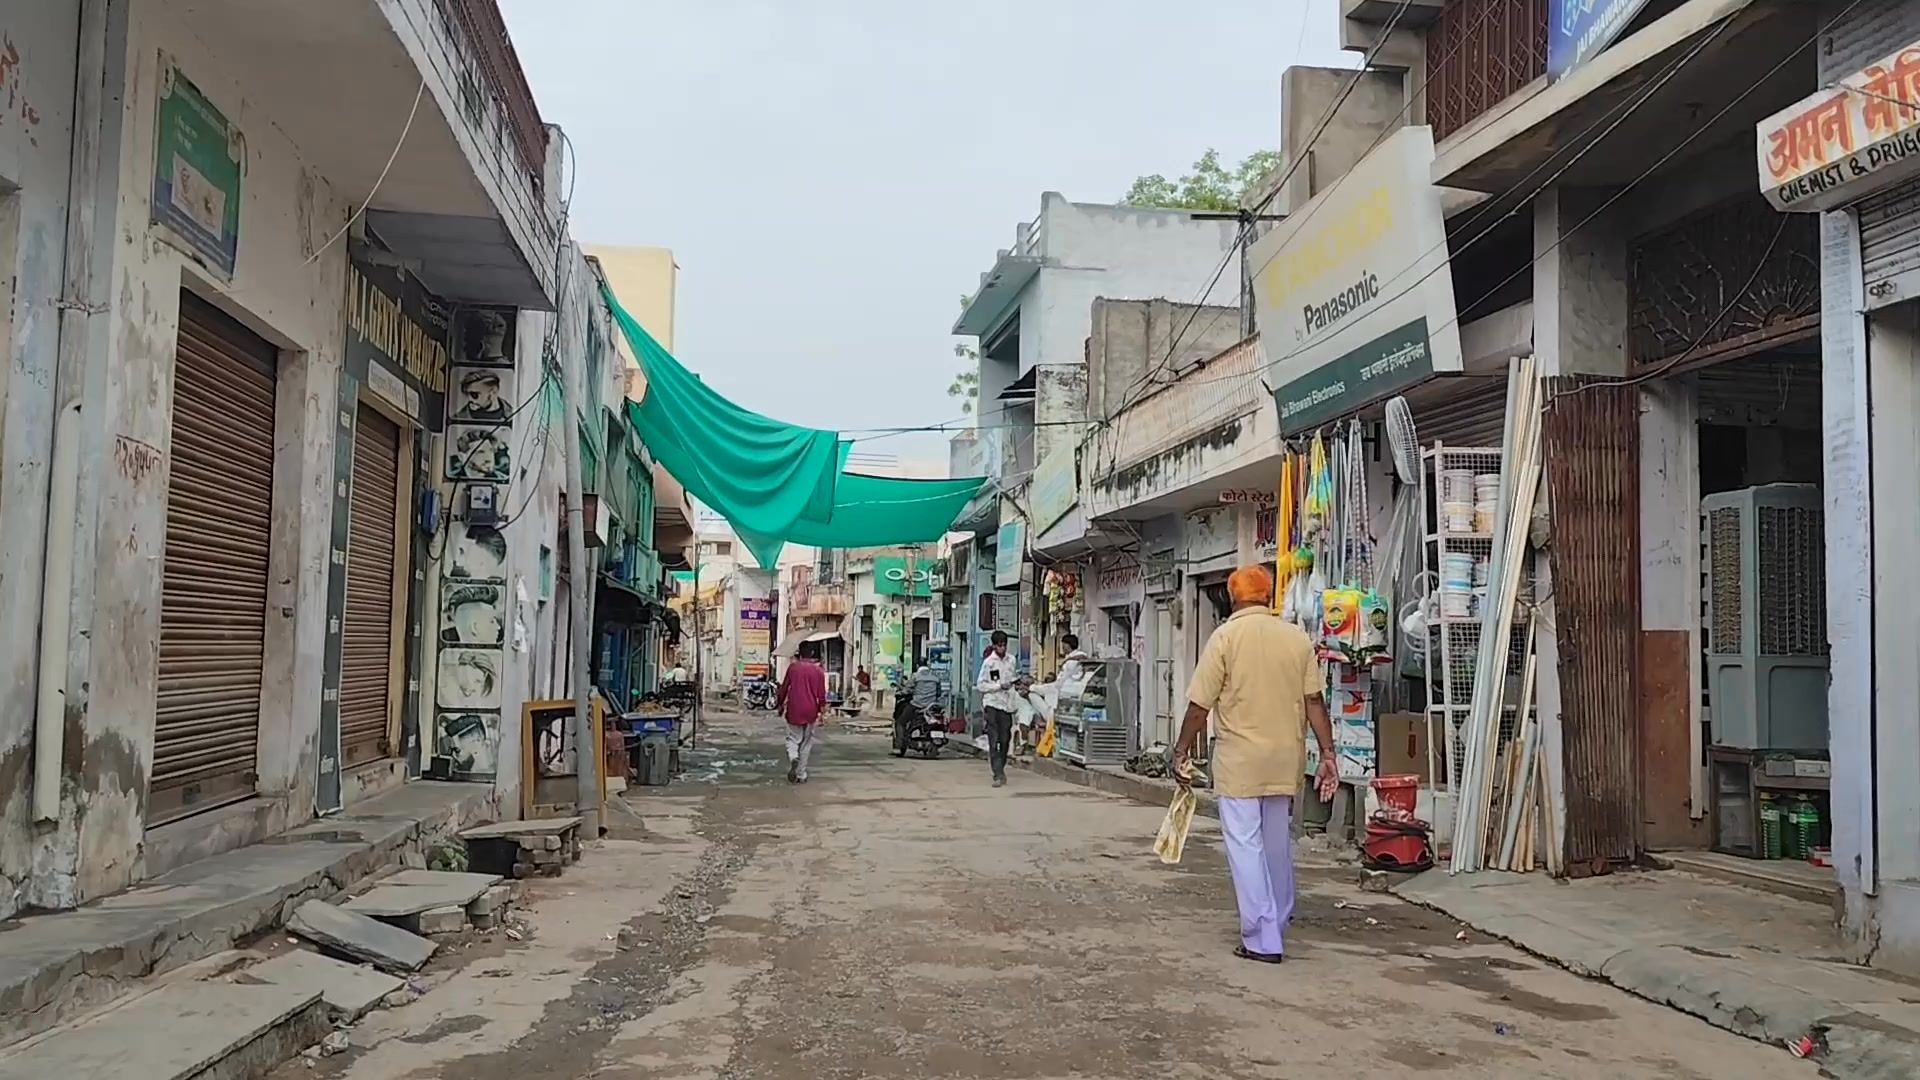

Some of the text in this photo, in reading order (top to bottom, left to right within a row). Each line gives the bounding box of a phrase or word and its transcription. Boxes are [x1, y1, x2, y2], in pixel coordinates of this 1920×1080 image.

[1765, 90, 1852, 178] अमन
[1849, 157, 1869, 177] &
[1303, 269, 1380, 335] Panasonic
[1311, 380, 1346, 405] Electronics
[1221, 488, 1248, 503] फोटो
